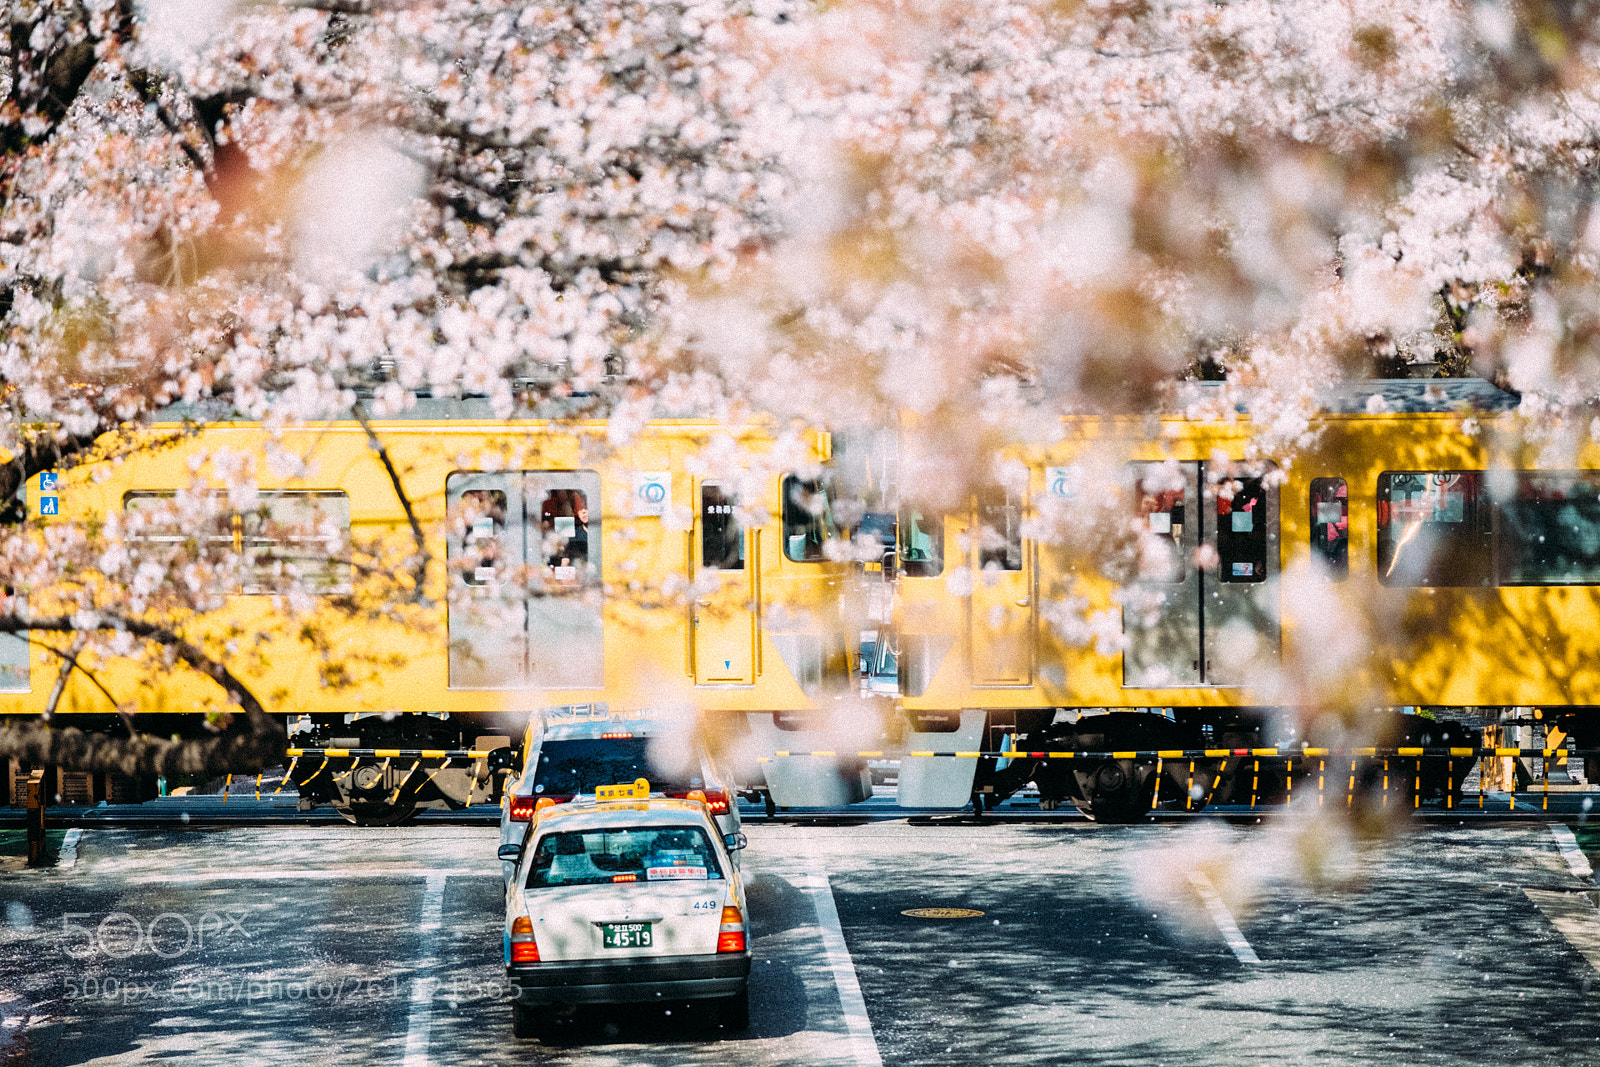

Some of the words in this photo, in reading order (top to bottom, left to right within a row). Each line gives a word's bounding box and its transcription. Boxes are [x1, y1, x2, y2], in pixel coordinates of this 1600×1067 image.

[693, 900, 716, 910] 449
[629, 923, 642, 932] 500
[613, 931, 651, 946] 45-19
